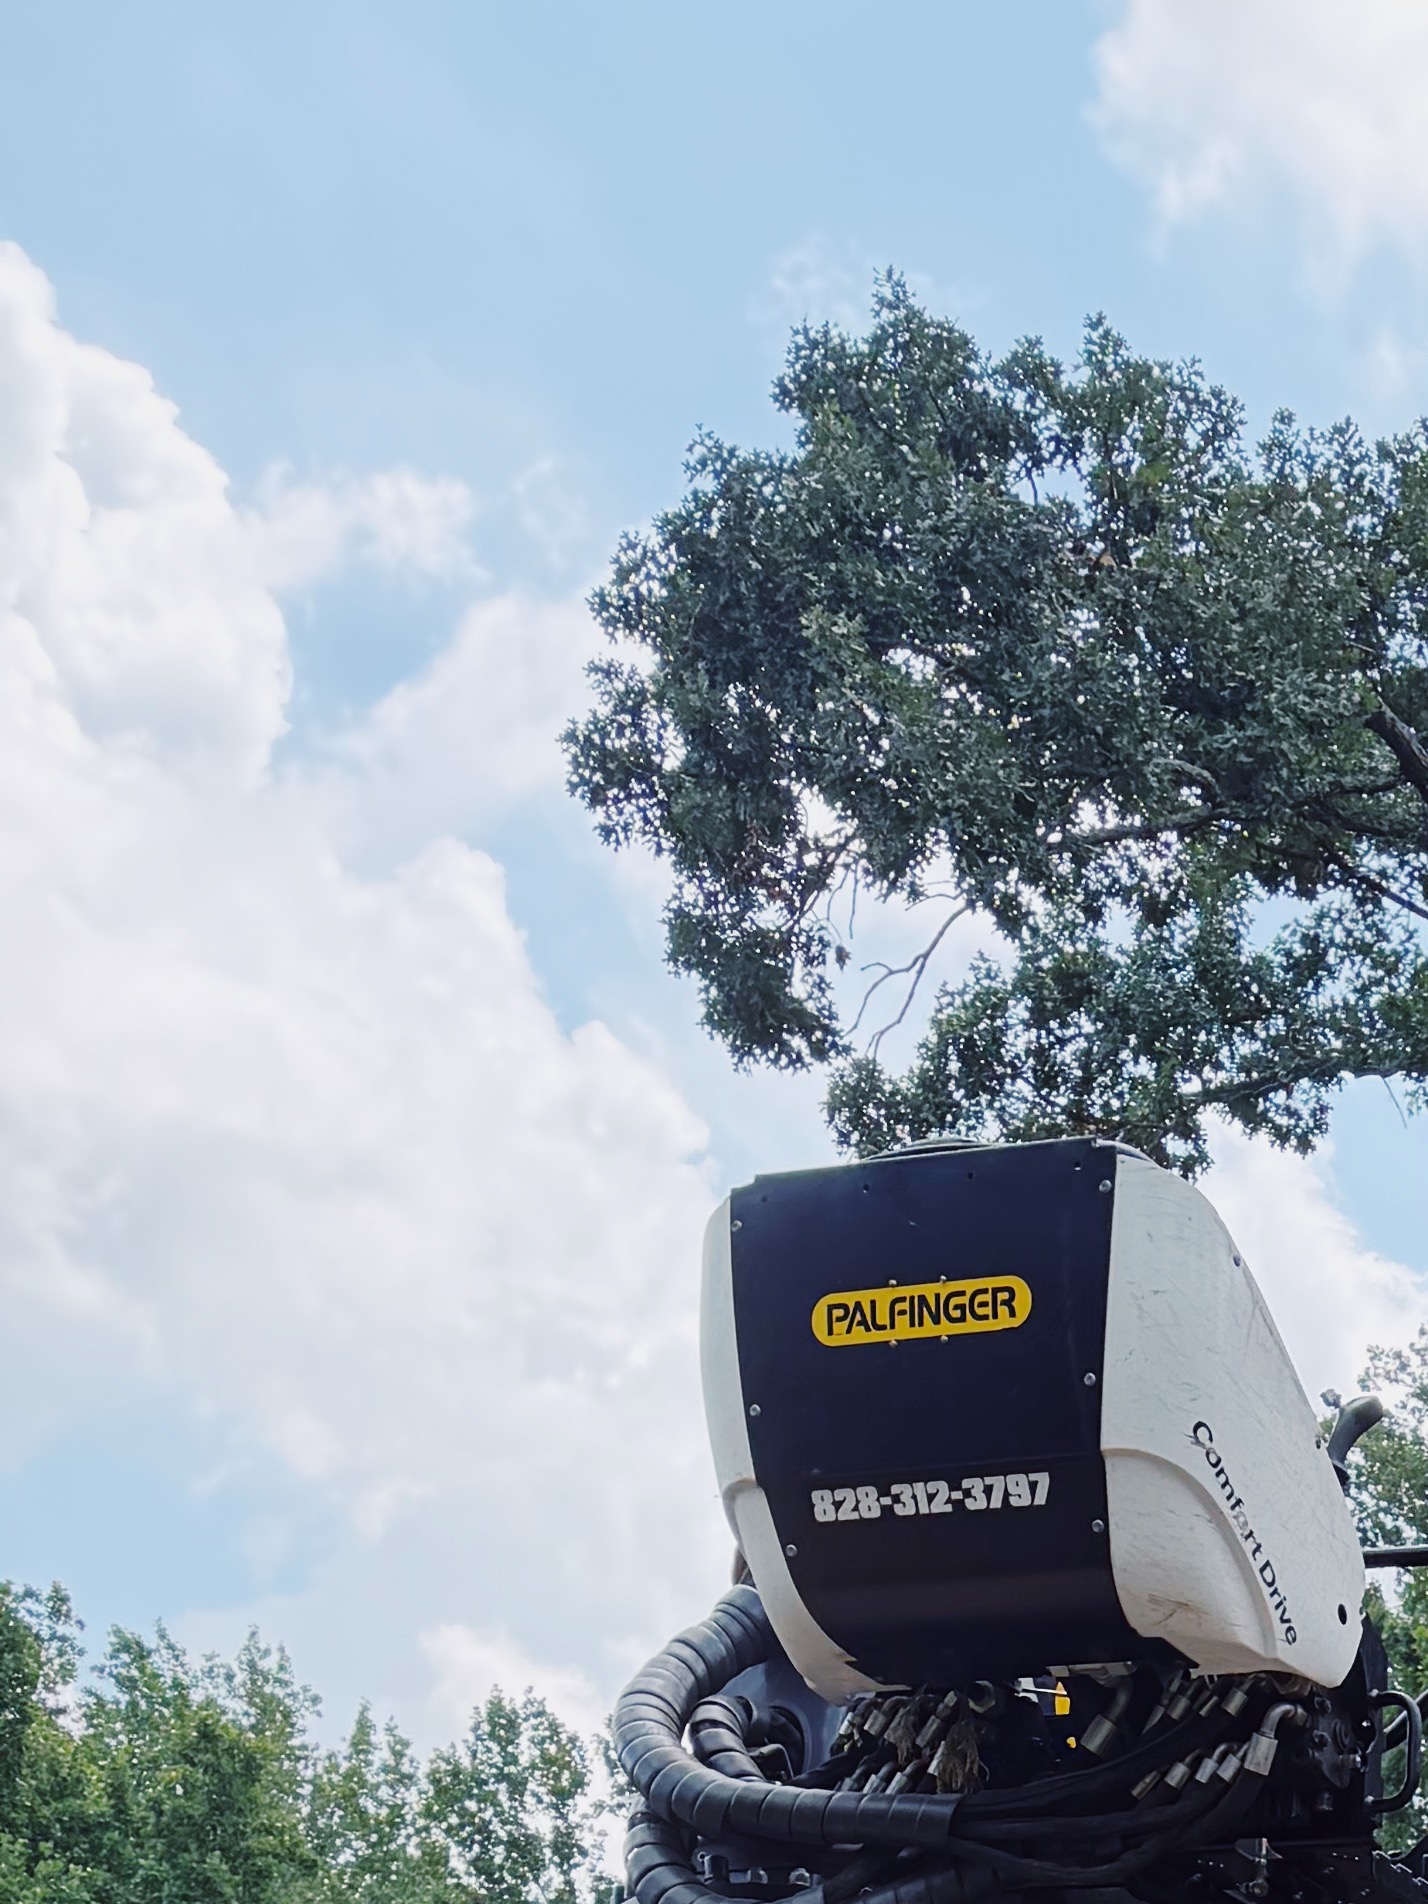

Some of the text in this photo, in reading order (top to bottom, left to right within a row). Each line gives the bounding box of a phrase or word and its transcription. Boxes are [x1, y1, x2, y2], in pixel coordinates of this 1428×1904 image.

[827, 1286, 1017, 1337] PALFINGER
[811, 1472, 1051, 1522] 828-312-3797
[1192, 1420, 1298, 1647] Comfort Drive
